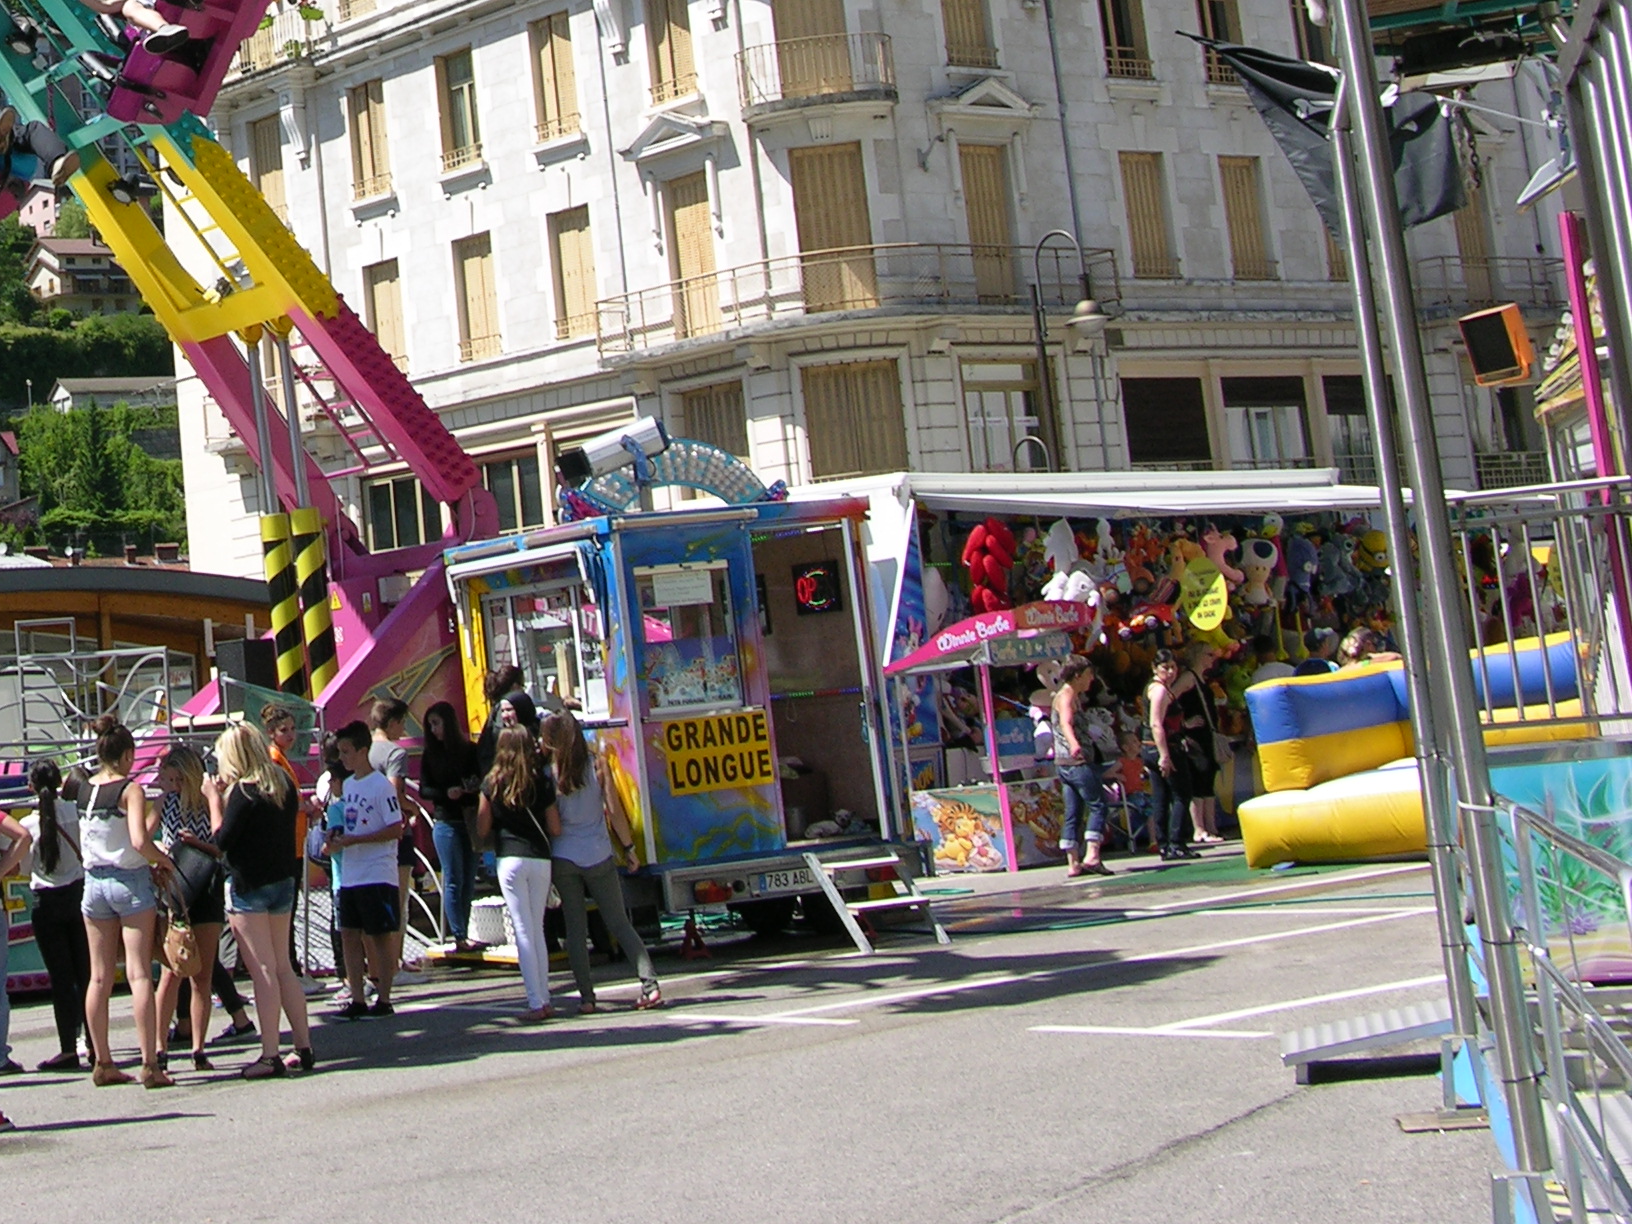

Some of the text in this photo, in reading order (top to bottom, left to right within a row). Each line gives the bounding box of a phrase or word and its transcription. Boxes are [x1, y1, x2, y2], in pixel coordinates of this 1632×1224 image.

[936, 629, 976, 652] Winnie
[666, 714, 767, 752] GRANDE
[670, 749, 772, 789] LONGUE
[767, 872, 789, 887] 783
